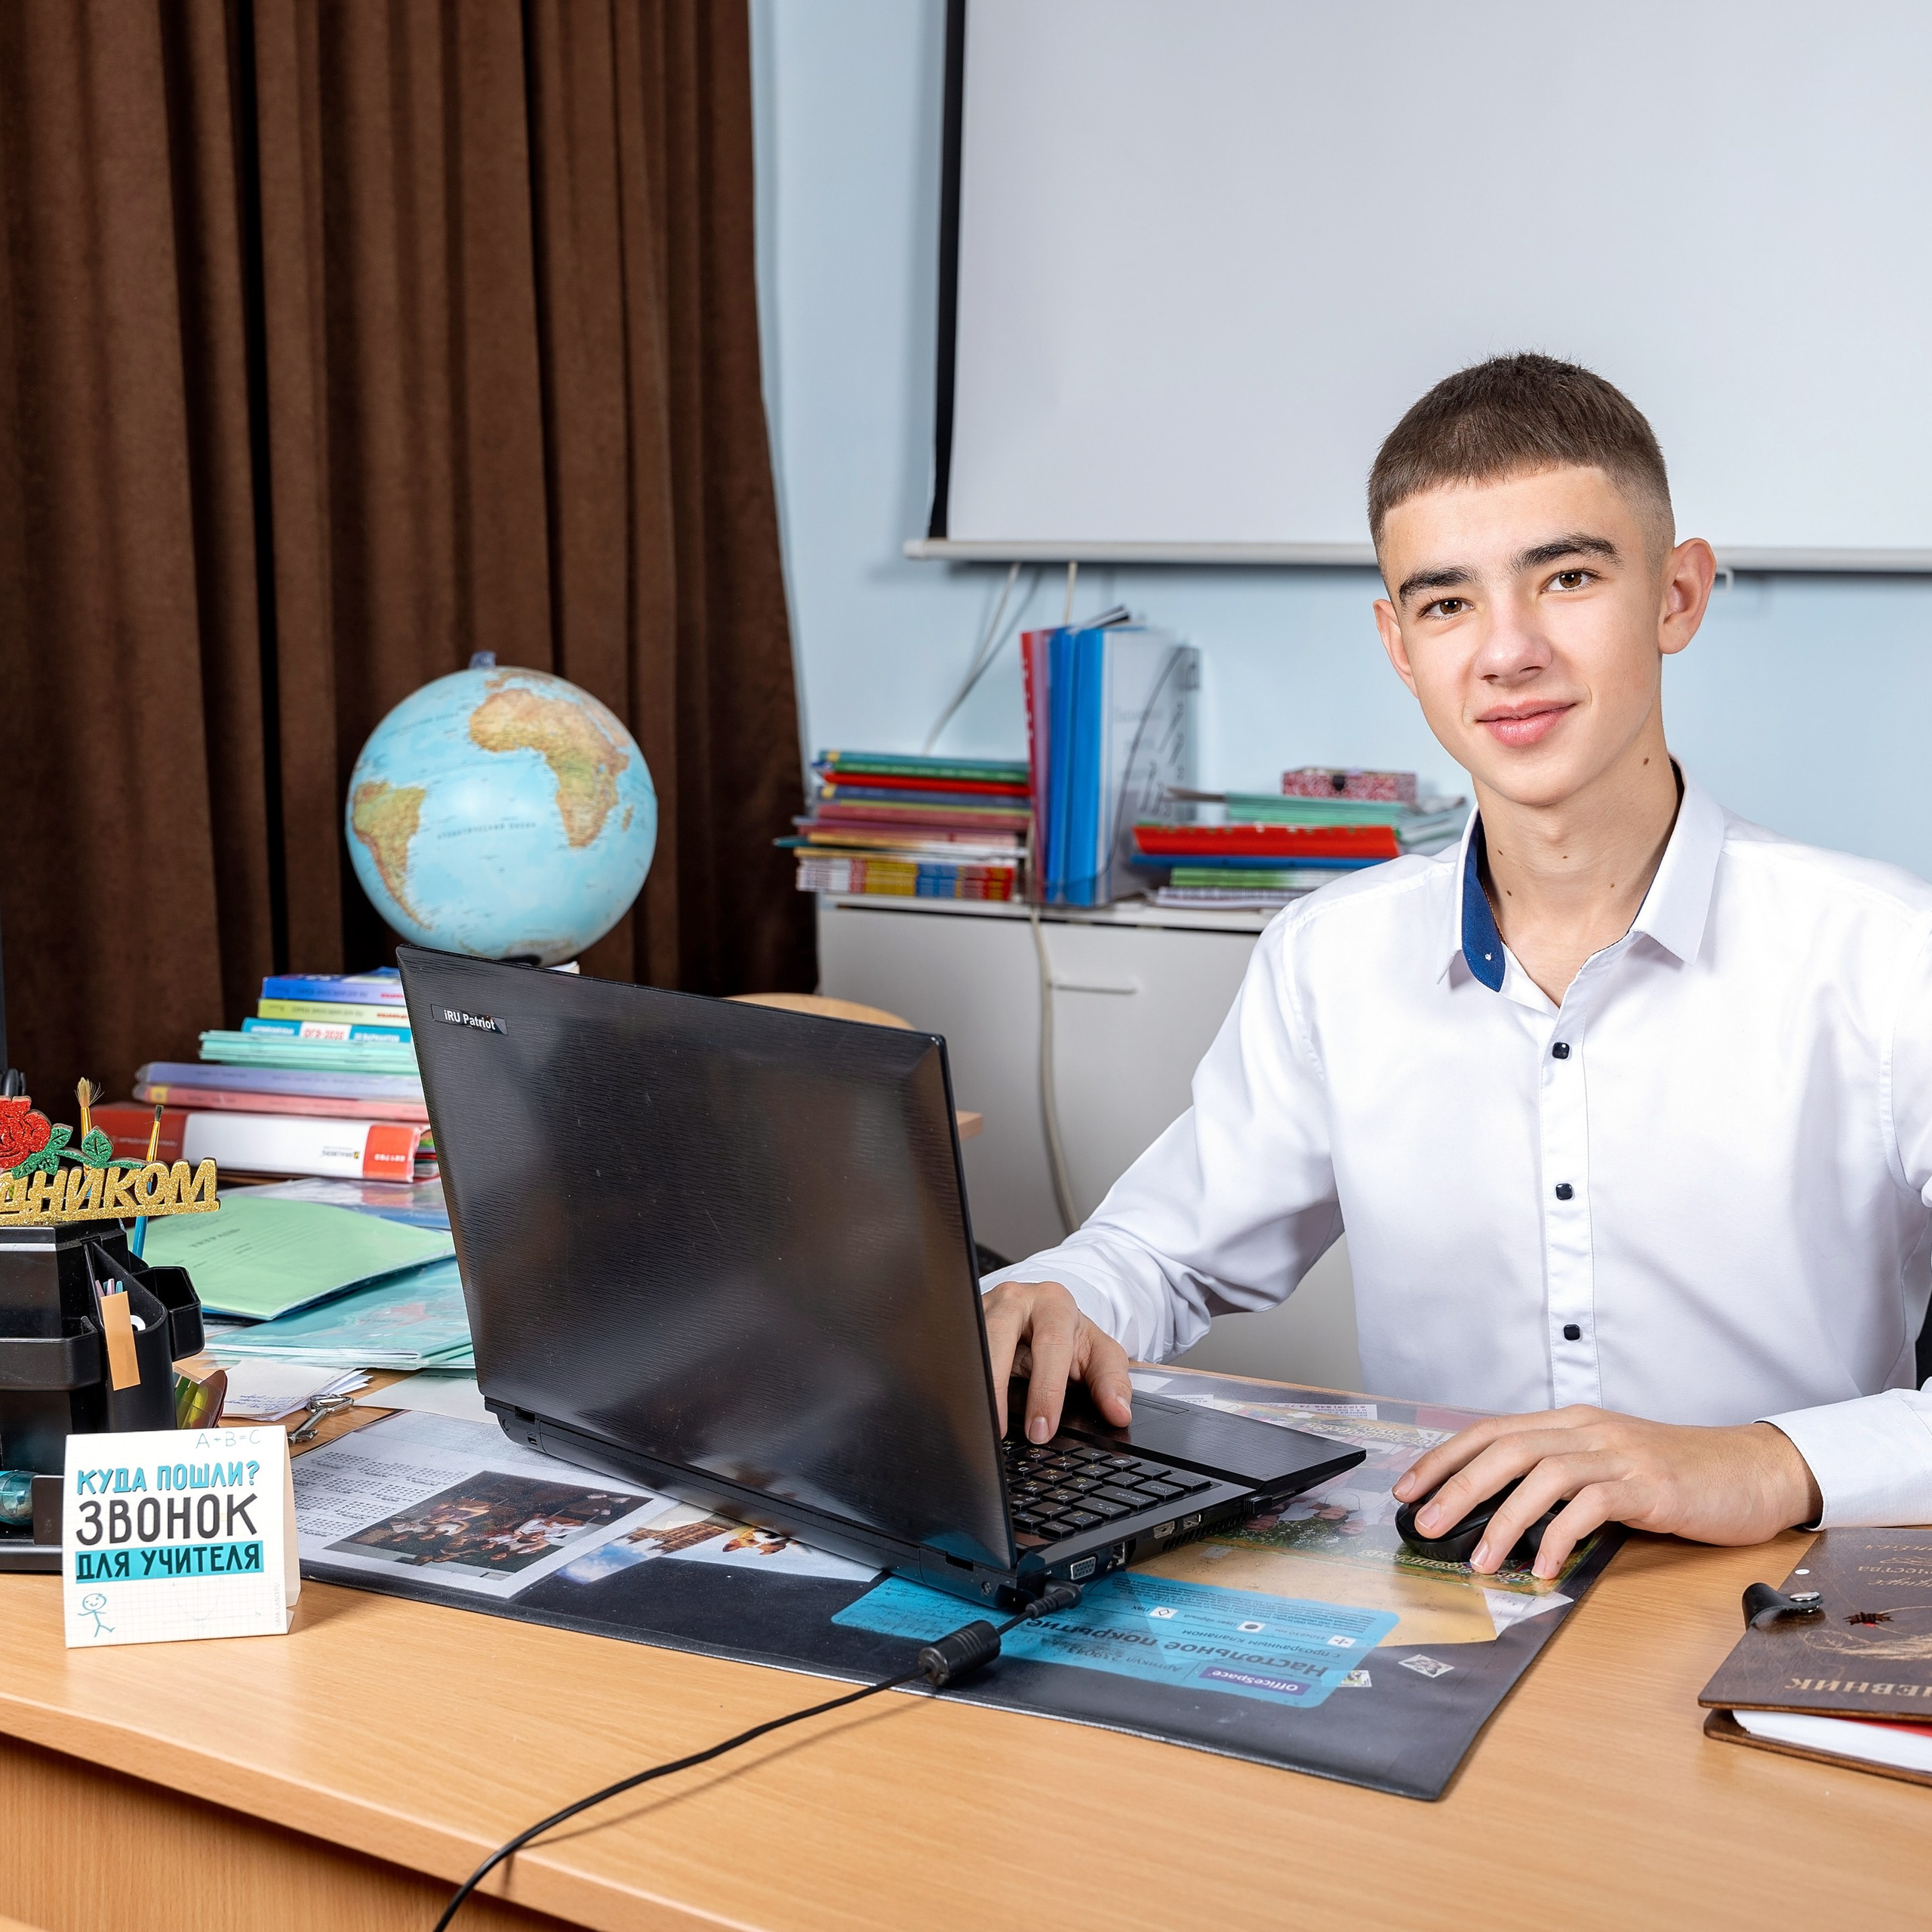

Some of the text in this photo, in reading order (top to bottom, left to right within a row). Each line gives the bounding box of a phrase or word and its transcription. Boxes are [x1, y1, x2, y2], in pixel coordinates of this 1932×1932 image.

[444, 1010, 496, 1030] iRU Patriot
[77, 1460, 260, 1495] КУДА ПОШЛИ?
[76, 1493, 258, 1546] ЗВОНОК
[76, 1543, 260, 1580] ДЛЯ УЧИТЕЛЯ
[1182, 1629, 1245, 1644] клапаном
[1026, 1618, 1329, 1677] Настольное покрытие
[1247, 1640, 1330, 1657] прозрачным
[1125, 1657, 1183, 1672] Артикул
[1211, 1670, 1299, 1691] OfficeSpace
[1786, 1678, 1932, 1697] ЕВНИК
